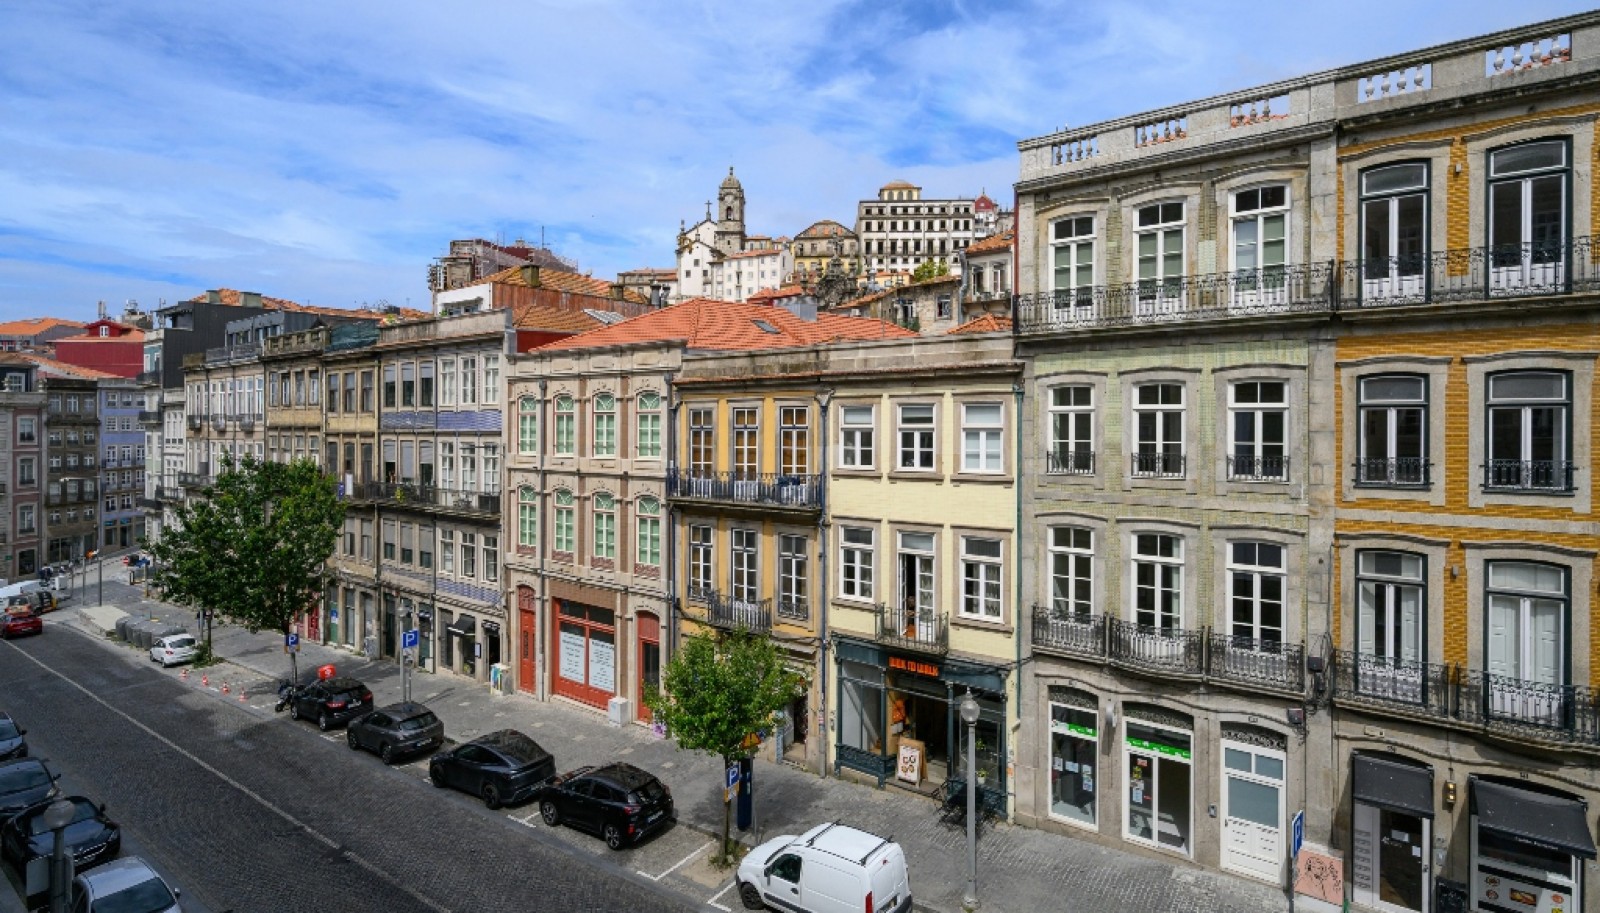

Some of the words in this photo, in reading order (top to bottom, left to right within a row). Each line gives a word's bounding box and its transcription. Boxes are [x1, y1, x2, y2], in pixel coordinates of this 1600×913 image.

[288, 635, 297, 646] P
[406, 633, 415, 647] P
[729, 768, 738, 786] P
[1295, 820, 1301, 852] P
